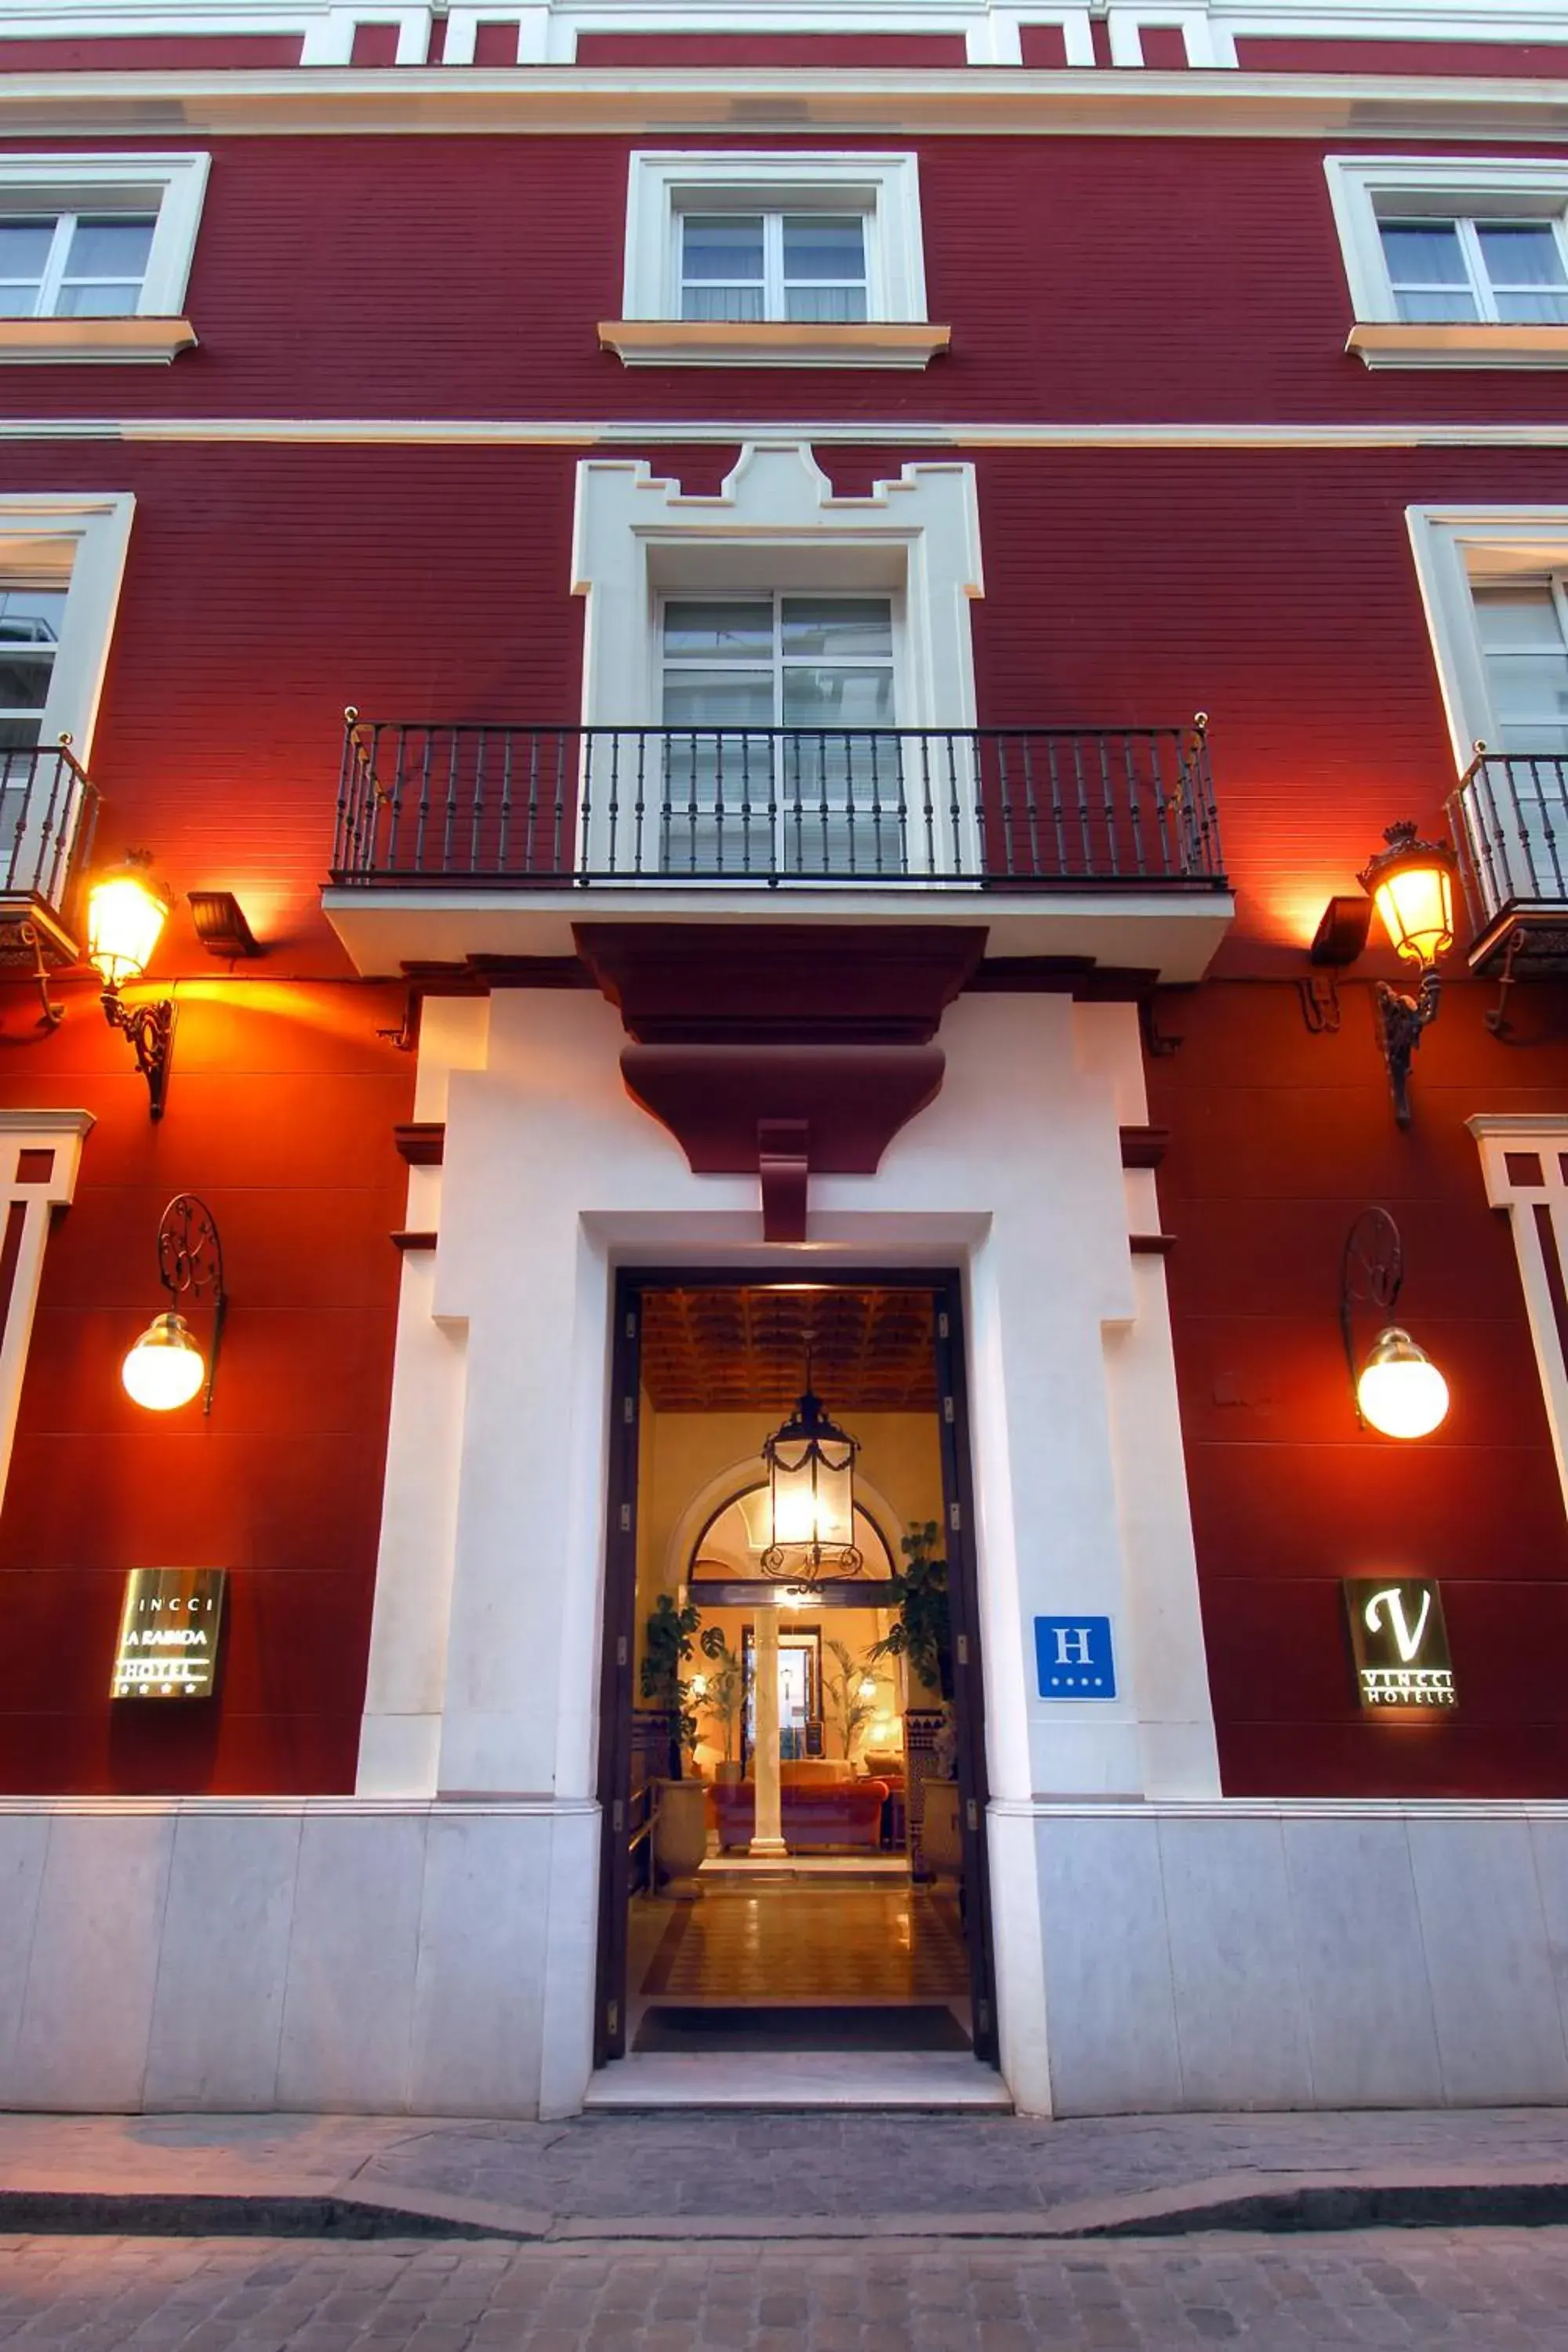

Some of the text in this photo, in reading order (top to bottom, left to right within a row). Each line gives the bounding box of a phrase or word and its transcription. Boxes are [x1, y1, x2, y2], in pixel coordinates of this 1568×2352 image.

[129, 1598, 213, 1612] INCCI
[1365, 1588, 1431, 1663] V
[1051, 1628, 1095, 1664] H
[124, 1661, 193, 1678] HOTEL
[1365, 1671, 1453, 1686] VINCCI
[1367, 1690, 1455, 1704] HOTELES
